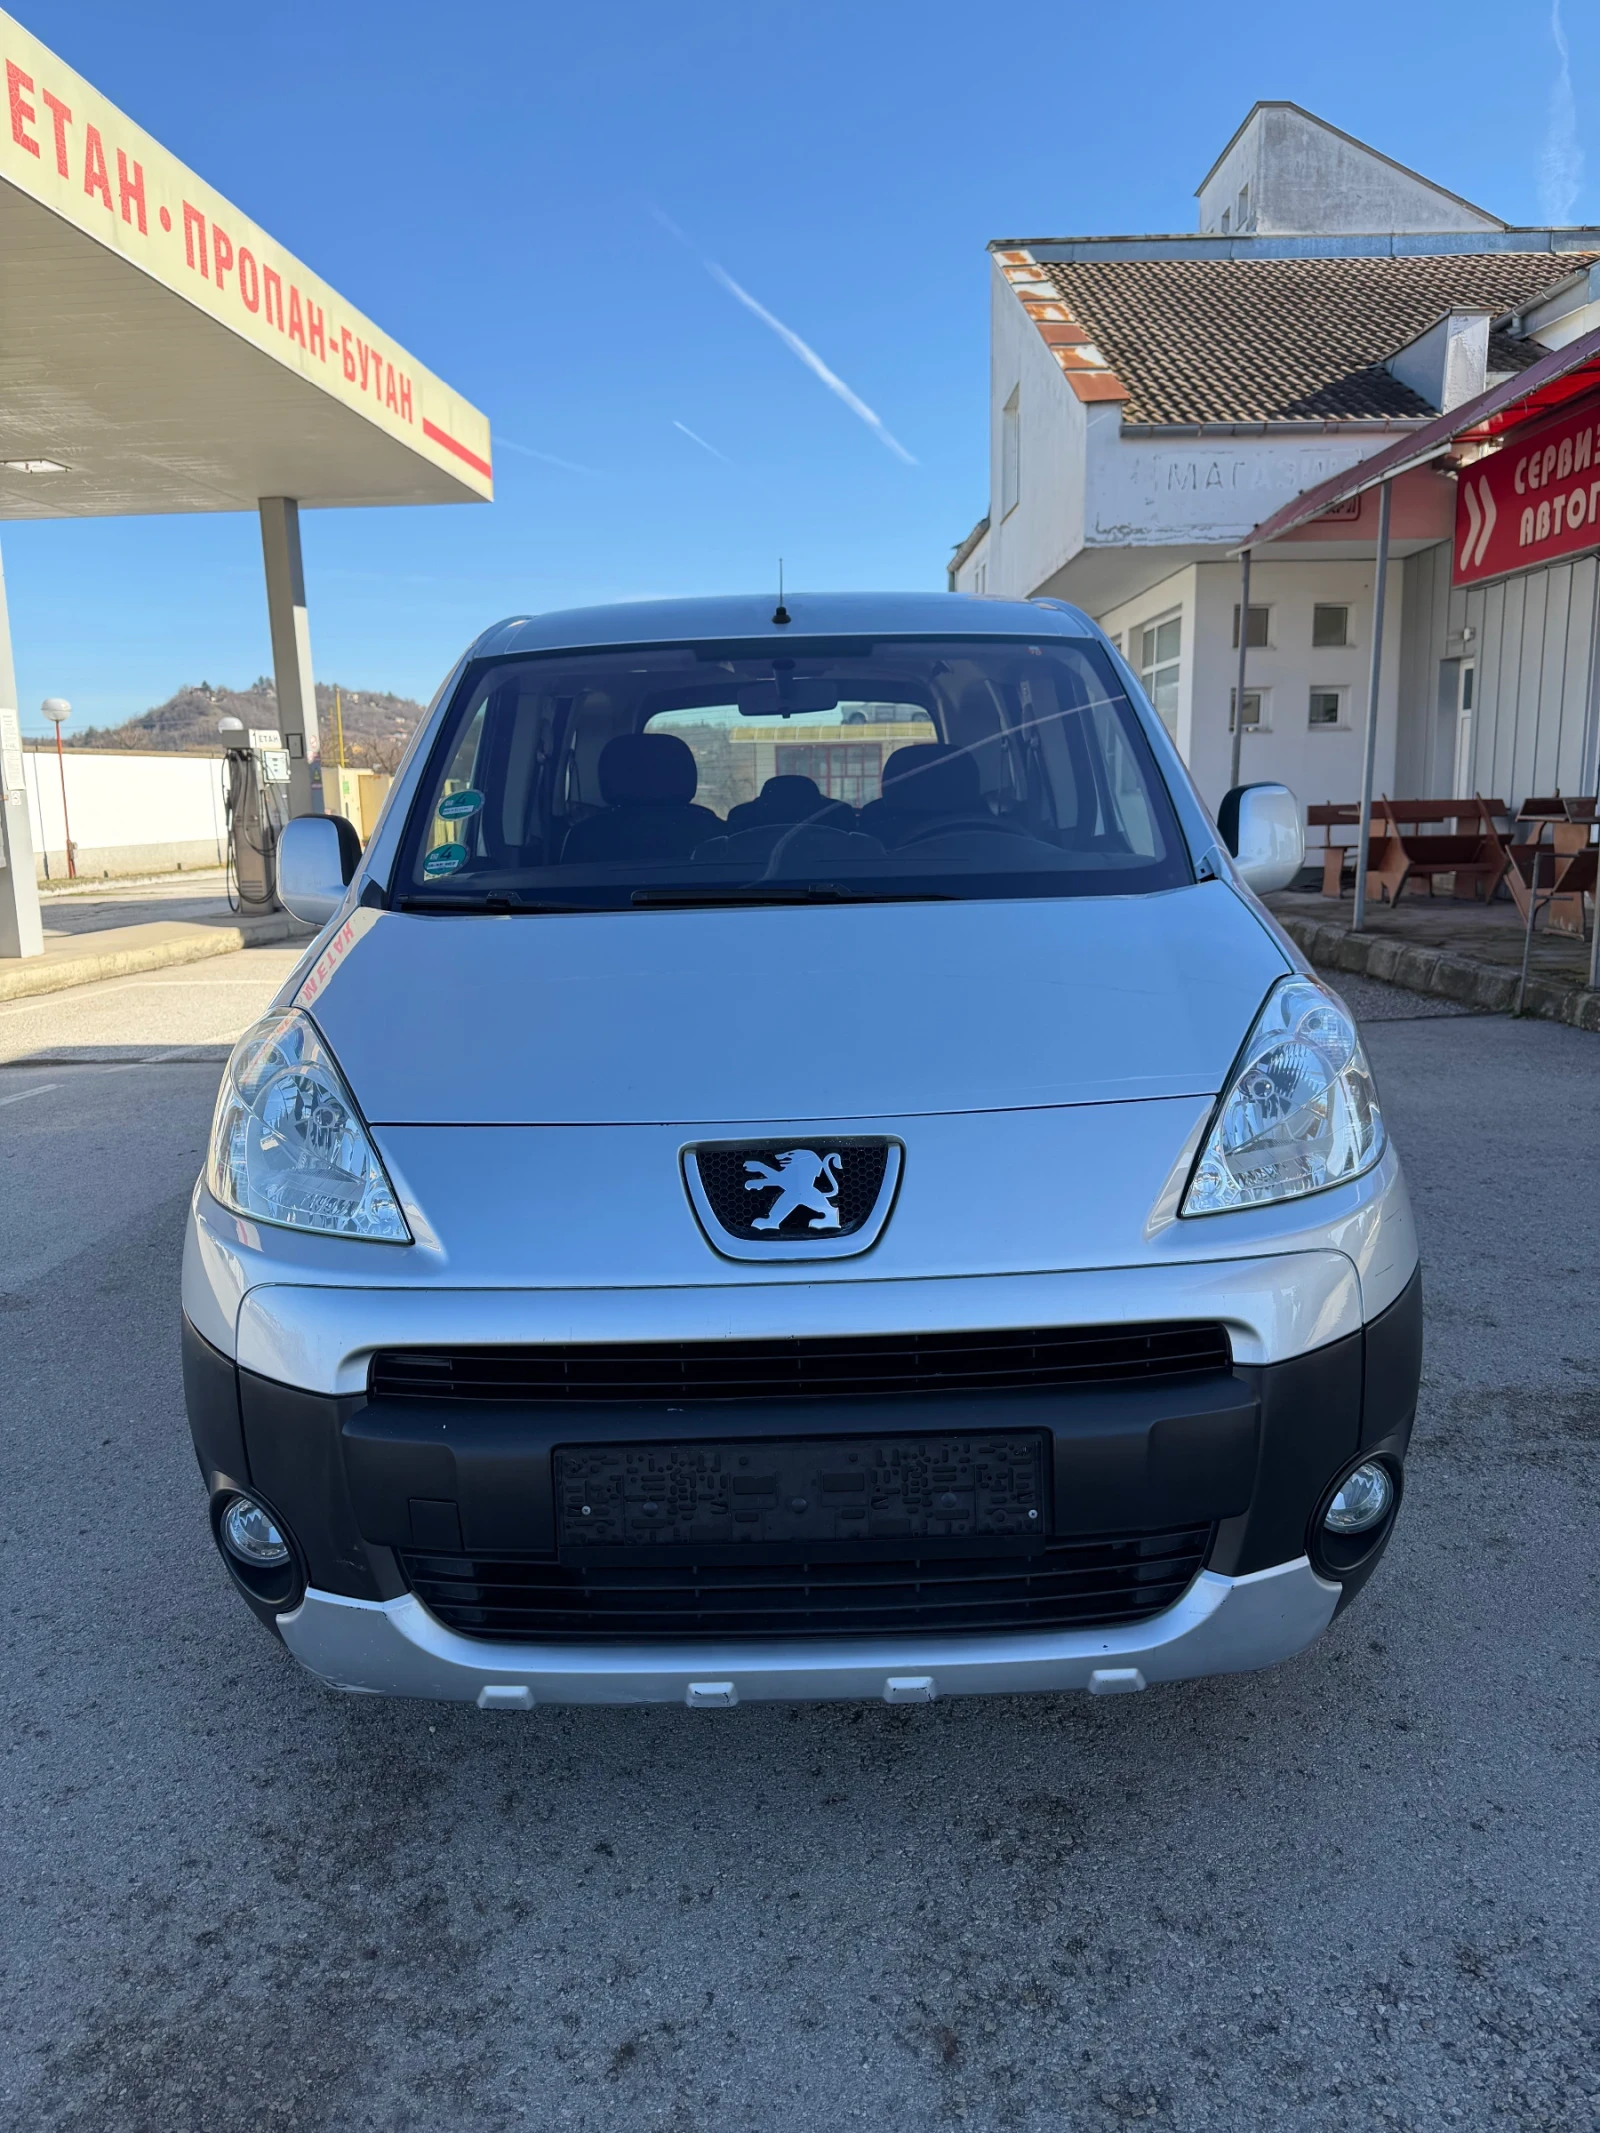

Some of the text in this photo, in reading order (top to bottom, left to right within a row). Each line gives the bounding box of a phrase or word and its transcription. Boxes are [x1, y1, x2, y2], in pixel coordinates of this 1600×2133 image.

[5, 58, 413, 424] ЕТАН ПРОПАН-БУТАН
[440, 846, 452, 859] 4
